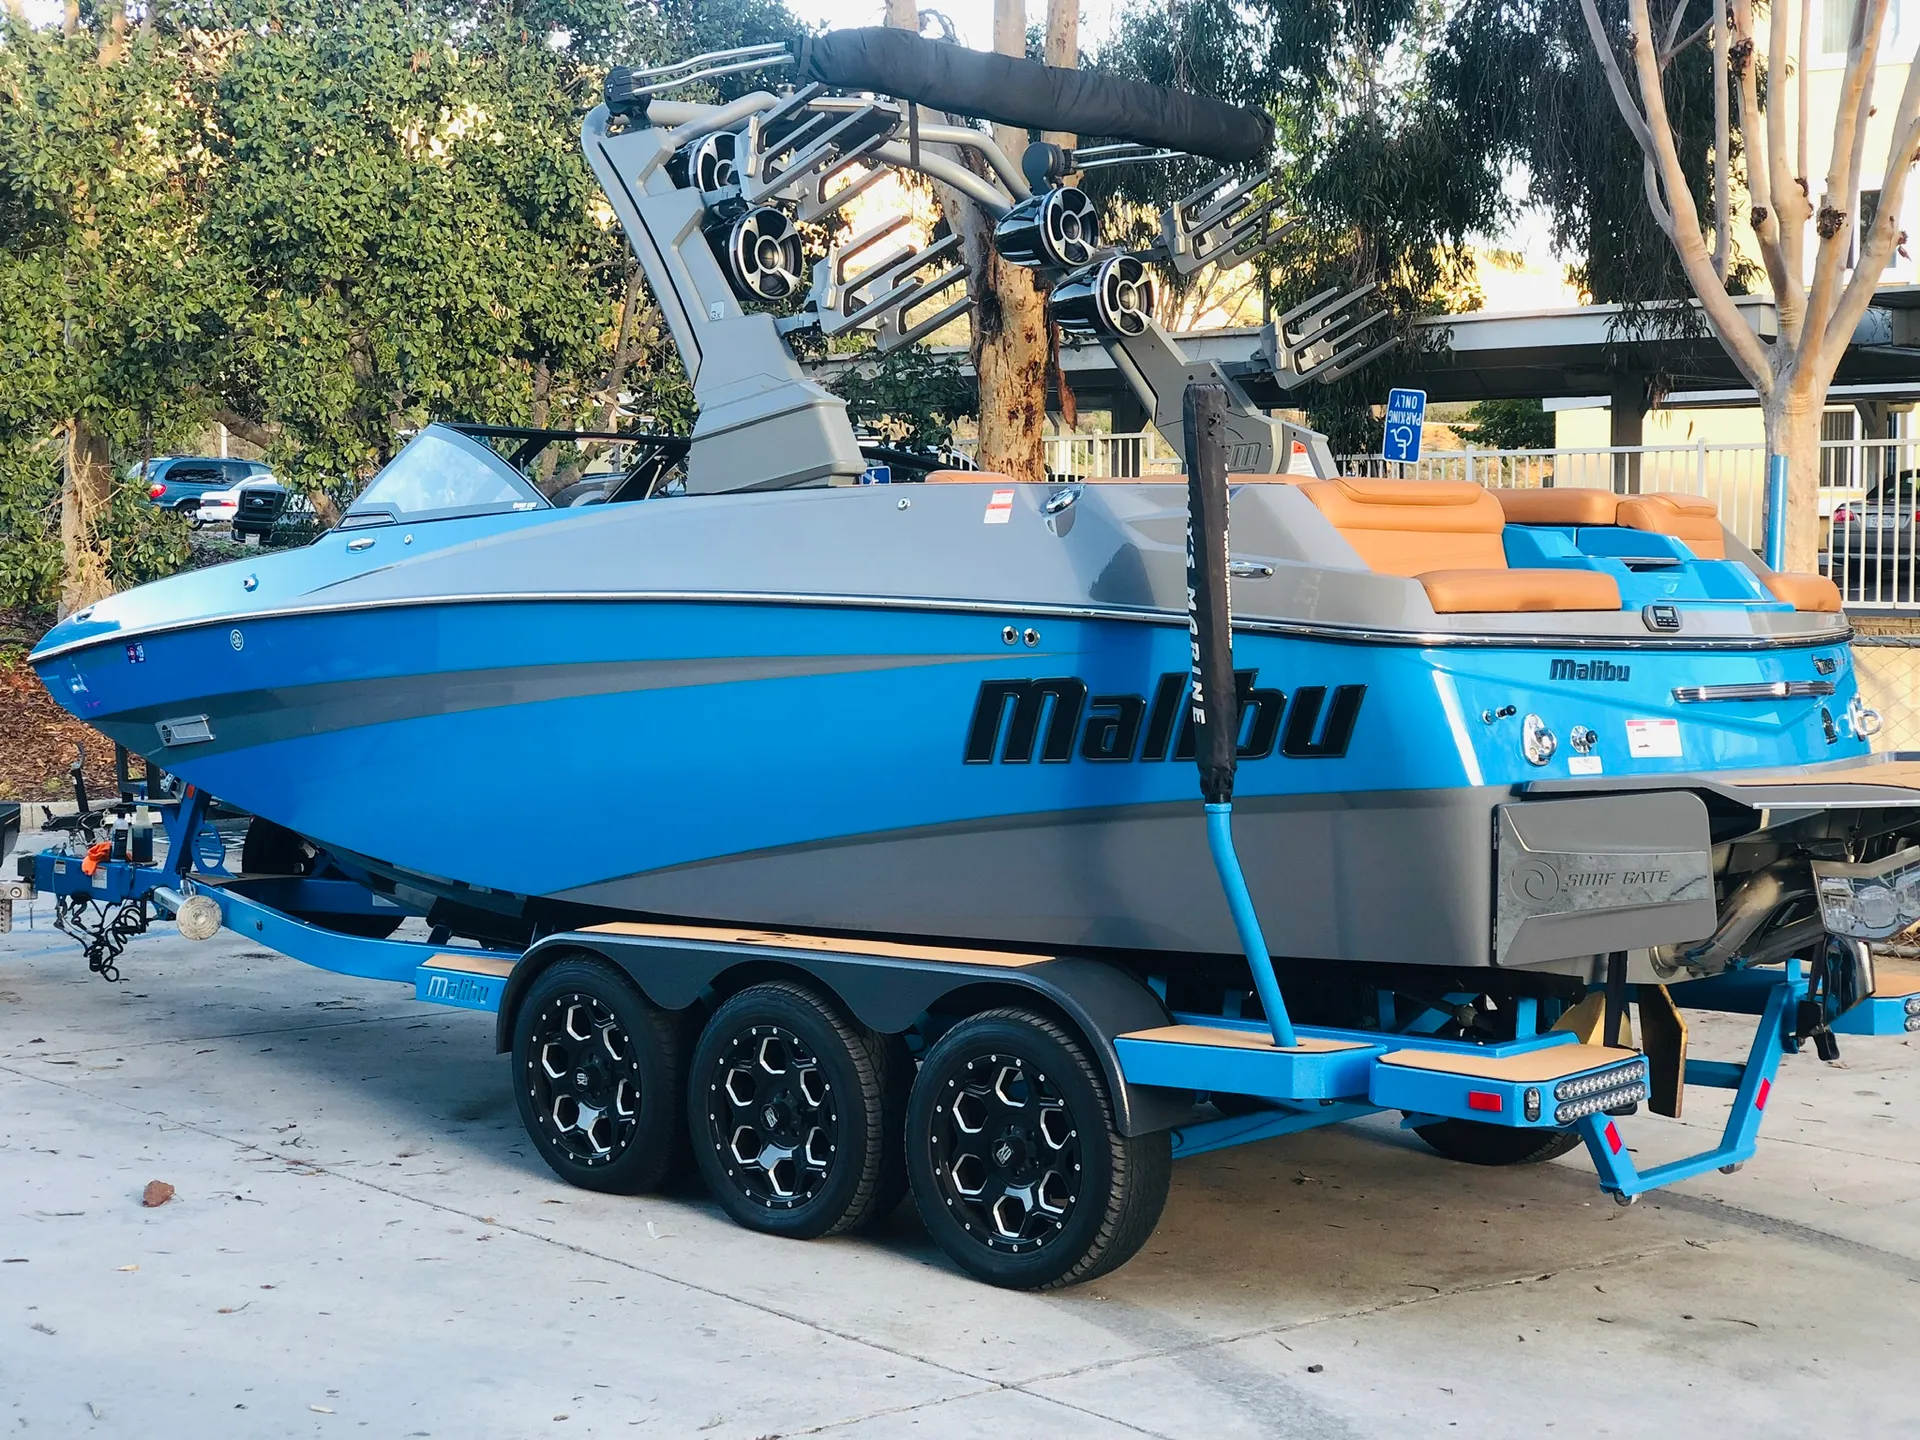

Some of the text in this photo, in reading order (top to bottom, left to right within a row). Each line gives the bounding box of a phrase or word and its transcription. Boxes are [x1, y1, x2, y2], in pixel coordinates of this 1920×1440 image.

[1394, 394, 1418, 409] ONLY
[1388, 410, 1422, 426] PARKING
[1186, 586, 1206, 724] MARINE
[1549, 658, 1631, 682] Malibu
[1565, 869, 1671, 887] SURF GATE
[426, 975, 490, 1005] Malibu
